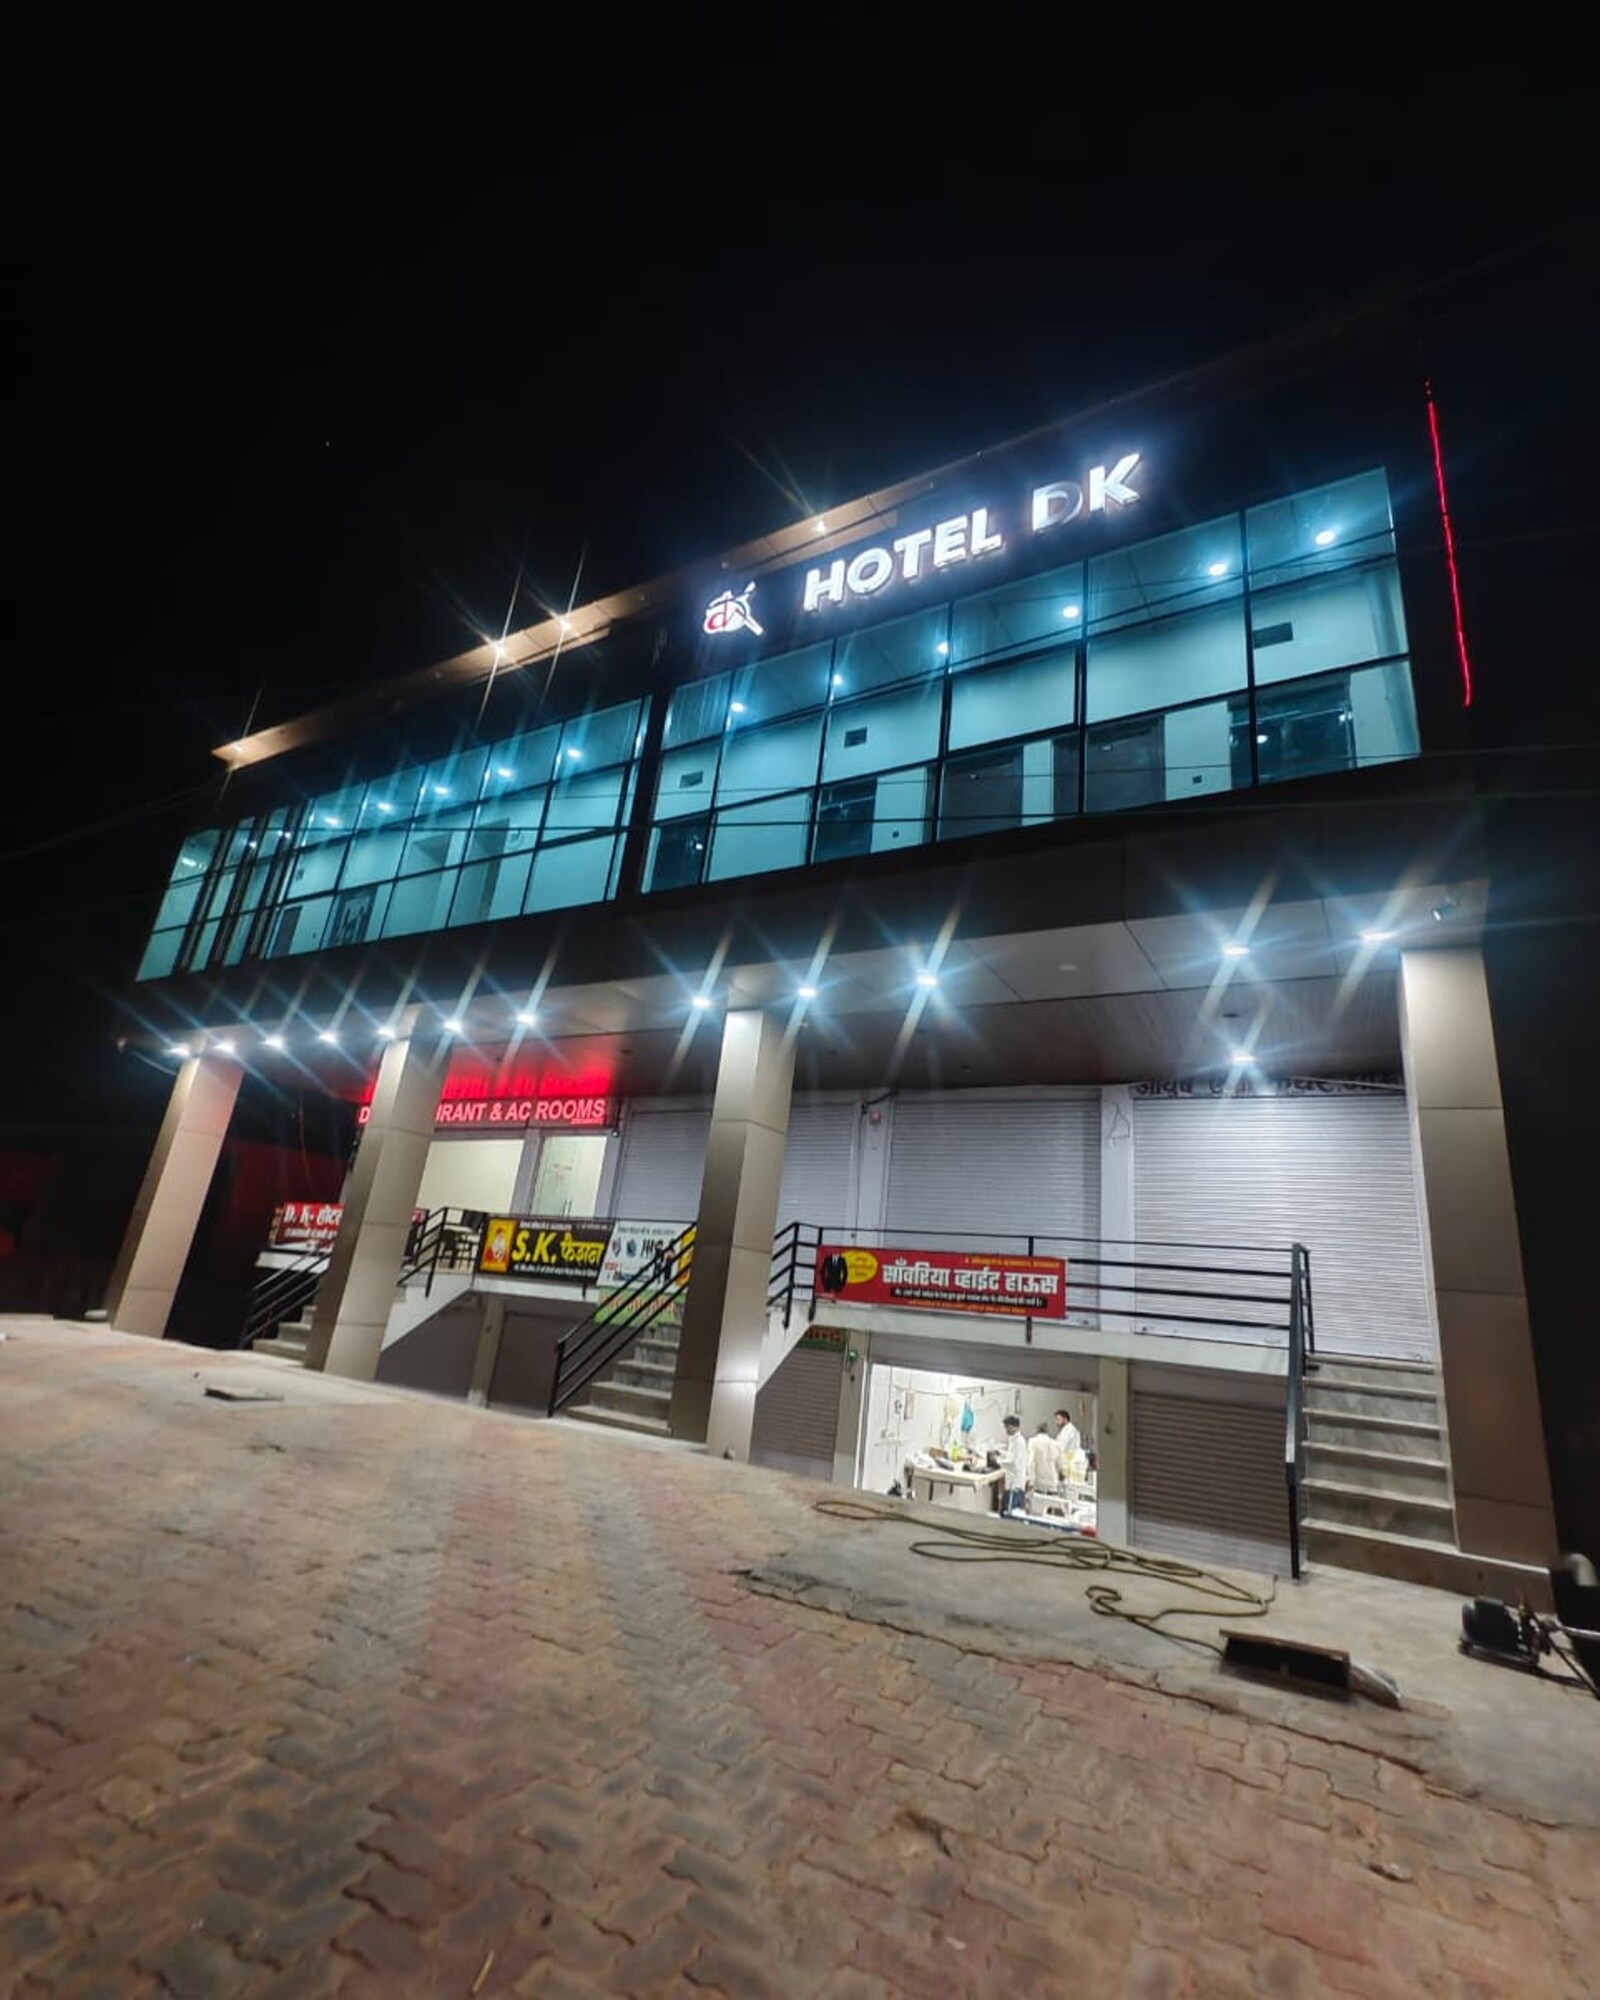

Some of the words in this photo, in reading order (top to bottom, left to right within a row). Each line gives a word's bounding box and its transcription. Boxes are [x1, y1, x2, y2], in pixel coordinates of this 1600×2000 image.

[802, 507, 1002, 613] HOTEL
[1032, 453, 1141, 532] DK
[489, 1102, 502, 1121] &
[505, 1102, 532, 1121] AC
[535, 1099, 606, 1120] ROOMS
